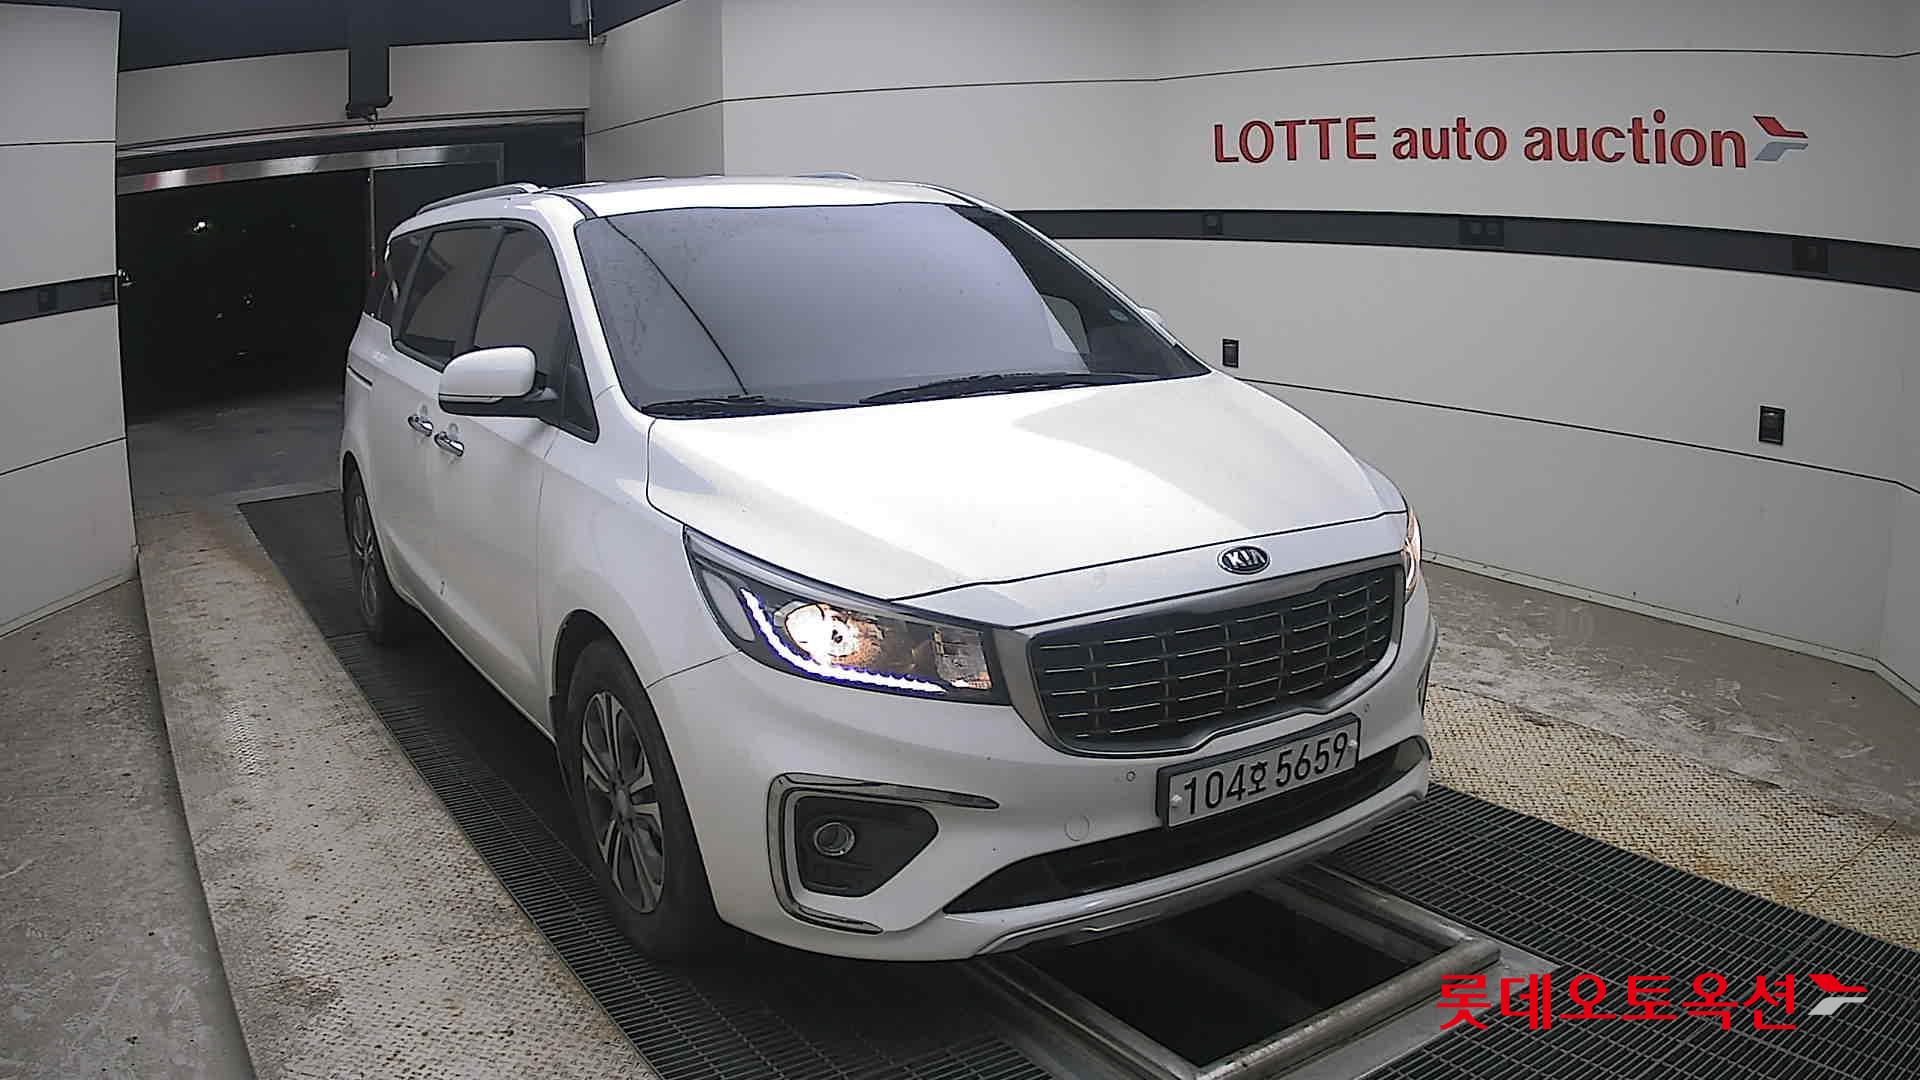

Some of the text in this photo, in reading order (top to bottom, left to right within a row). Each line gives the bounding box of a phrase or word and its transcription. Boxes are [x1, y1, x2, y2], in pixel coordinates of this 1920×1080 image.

[1213, 109, 1747, 168] LOTTE auto auction
[1225, 549, 1266, 567] KIA
